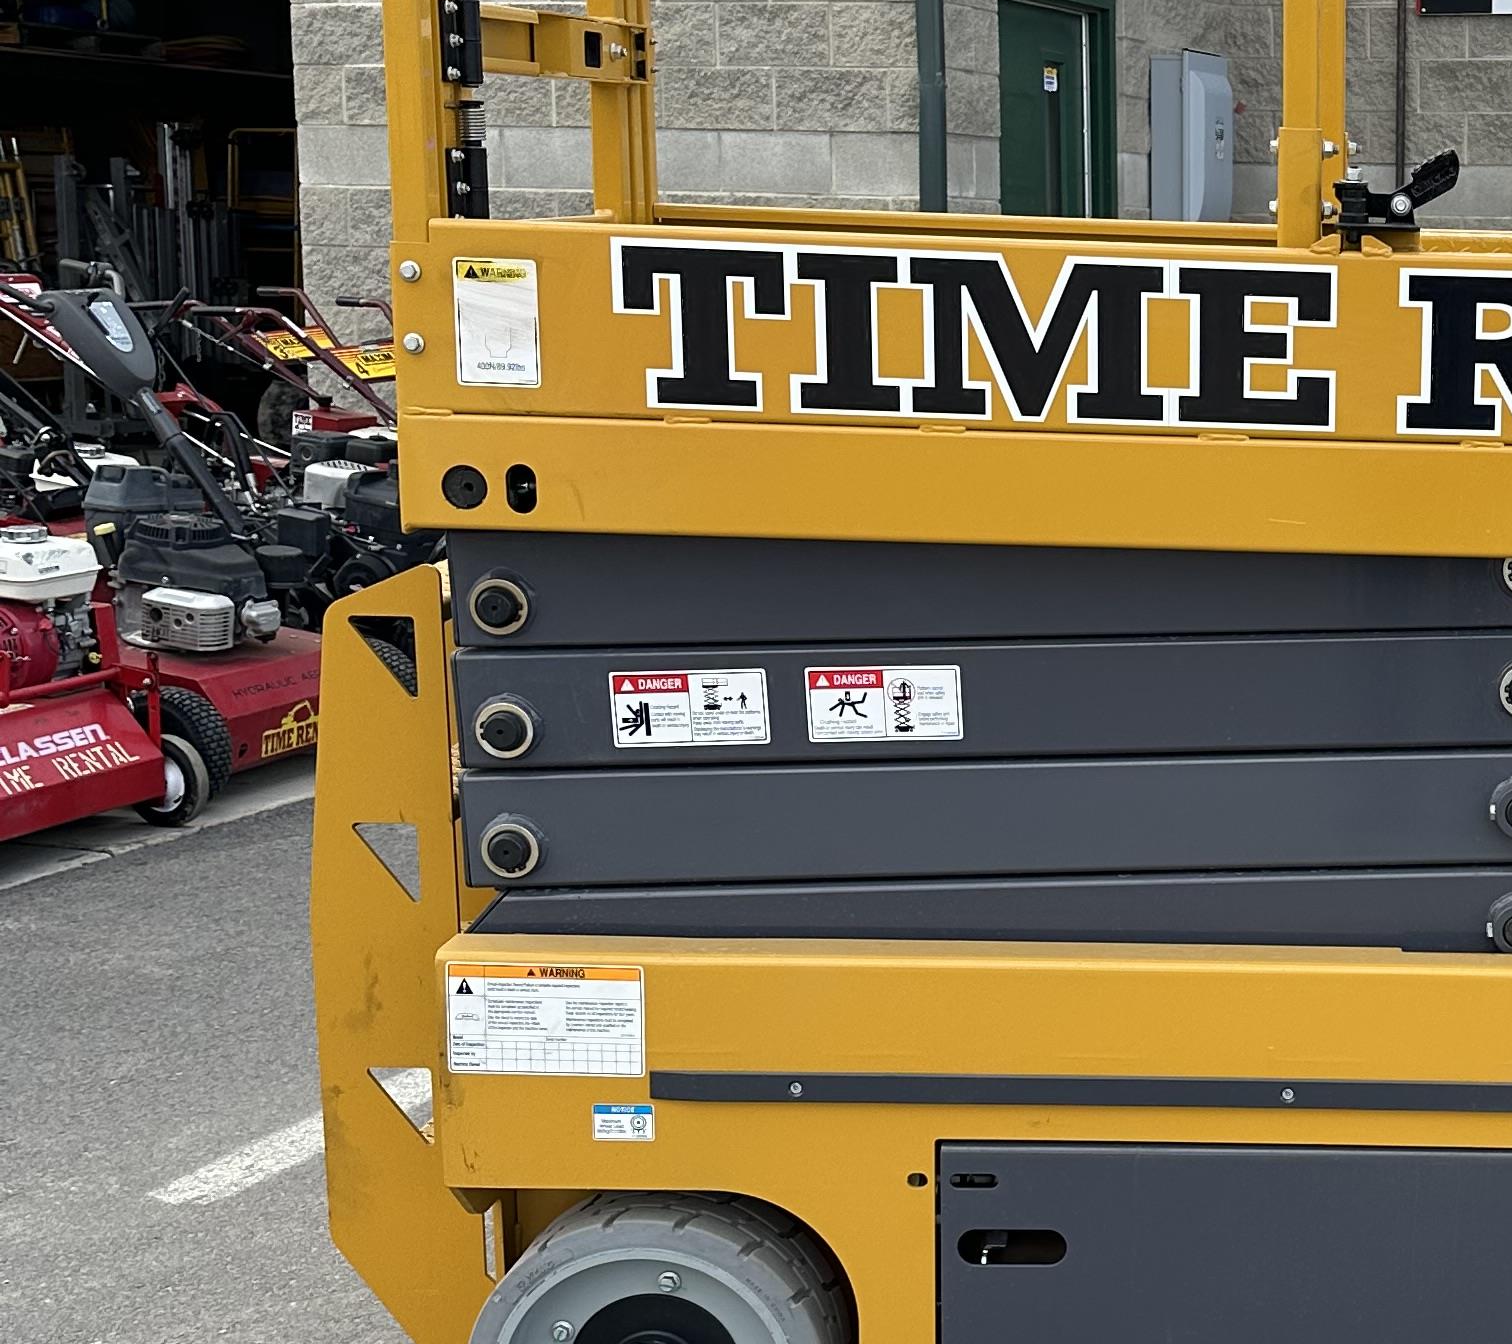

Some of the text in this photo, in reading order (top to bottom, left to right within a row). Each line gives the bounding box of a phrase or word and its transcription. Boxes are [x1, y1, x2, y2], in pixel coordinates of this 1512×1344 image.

[611, 237, 1338, 432] TIME
[637, 678, 683, 690] DANGER
[833, 673, 877, 686] DANGER
[264, 728, 295, 755] TIME
[51, 741, 140, 780] RENTAL
[539, 967, 586, 979] WARNING
